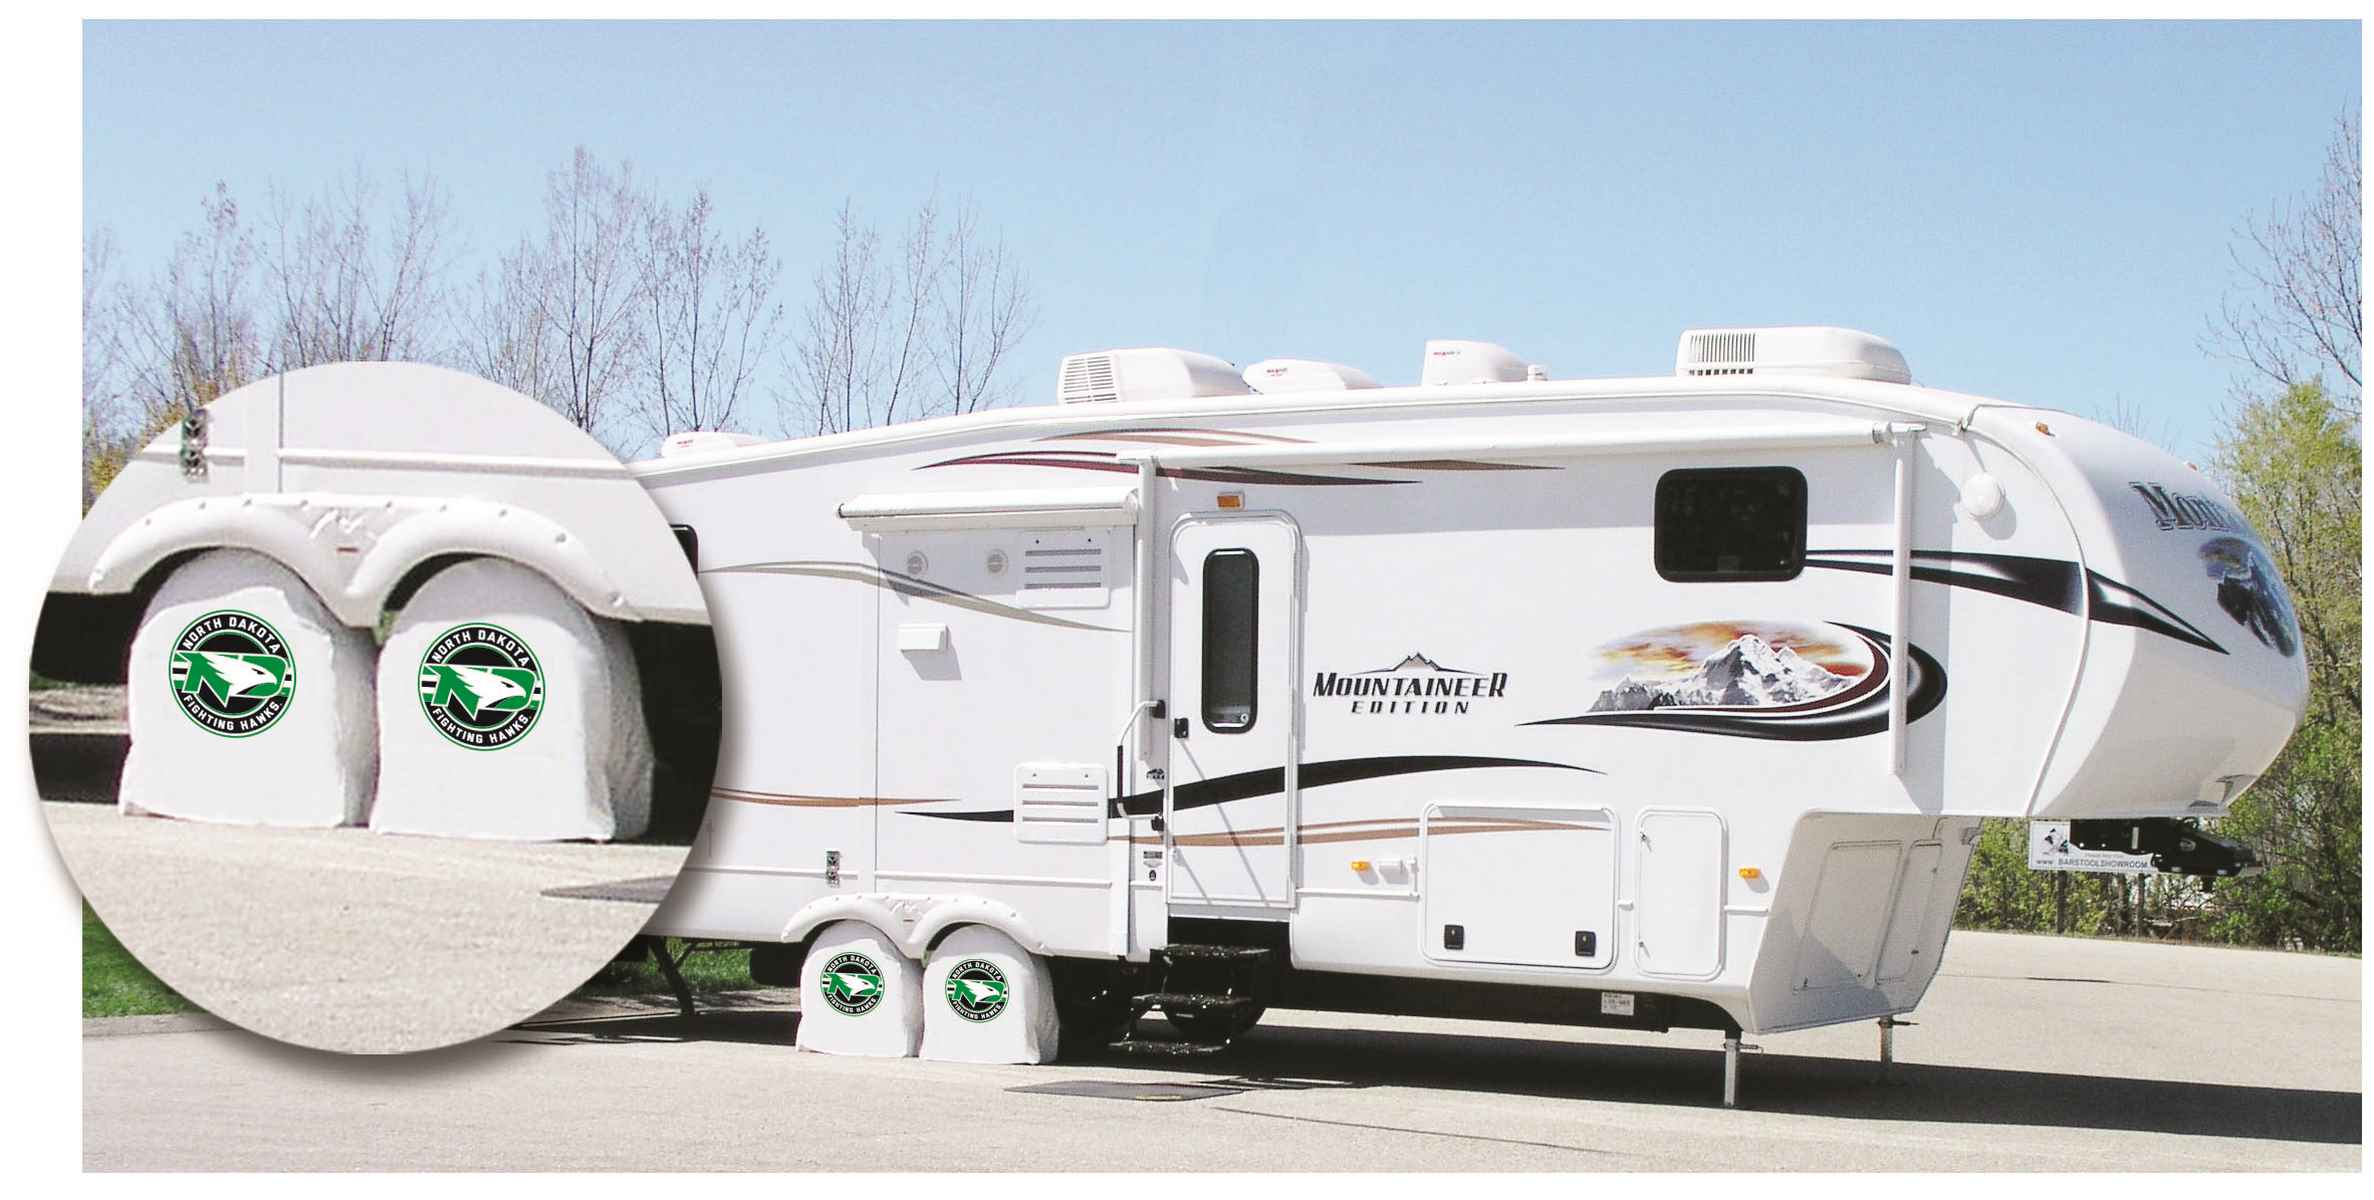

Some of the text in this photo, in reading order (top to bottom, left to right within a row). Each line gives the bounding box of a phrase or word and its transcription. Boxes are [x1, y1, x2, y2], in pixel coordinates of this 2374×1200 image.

[182, 616, 281, 654] NORTH DAKOTA
[431, 629, 530, 667] NORTH DAKOTA
[1313, 672, 1508, 698] MOUNTAINEER
[183, 694, 280, 731] FIGHTING HAWKS
[1351, 701, 1469, 714] EDITION
[432, 707, 529, 744] FIGHTING HAWKS
[827, 955, 877, 974] NORTH DAKOTA
[952, 961, 1002, 980] NORTH DAKOTA
[952, 1001, 1002, 1019] FIGHTING HAWKS
